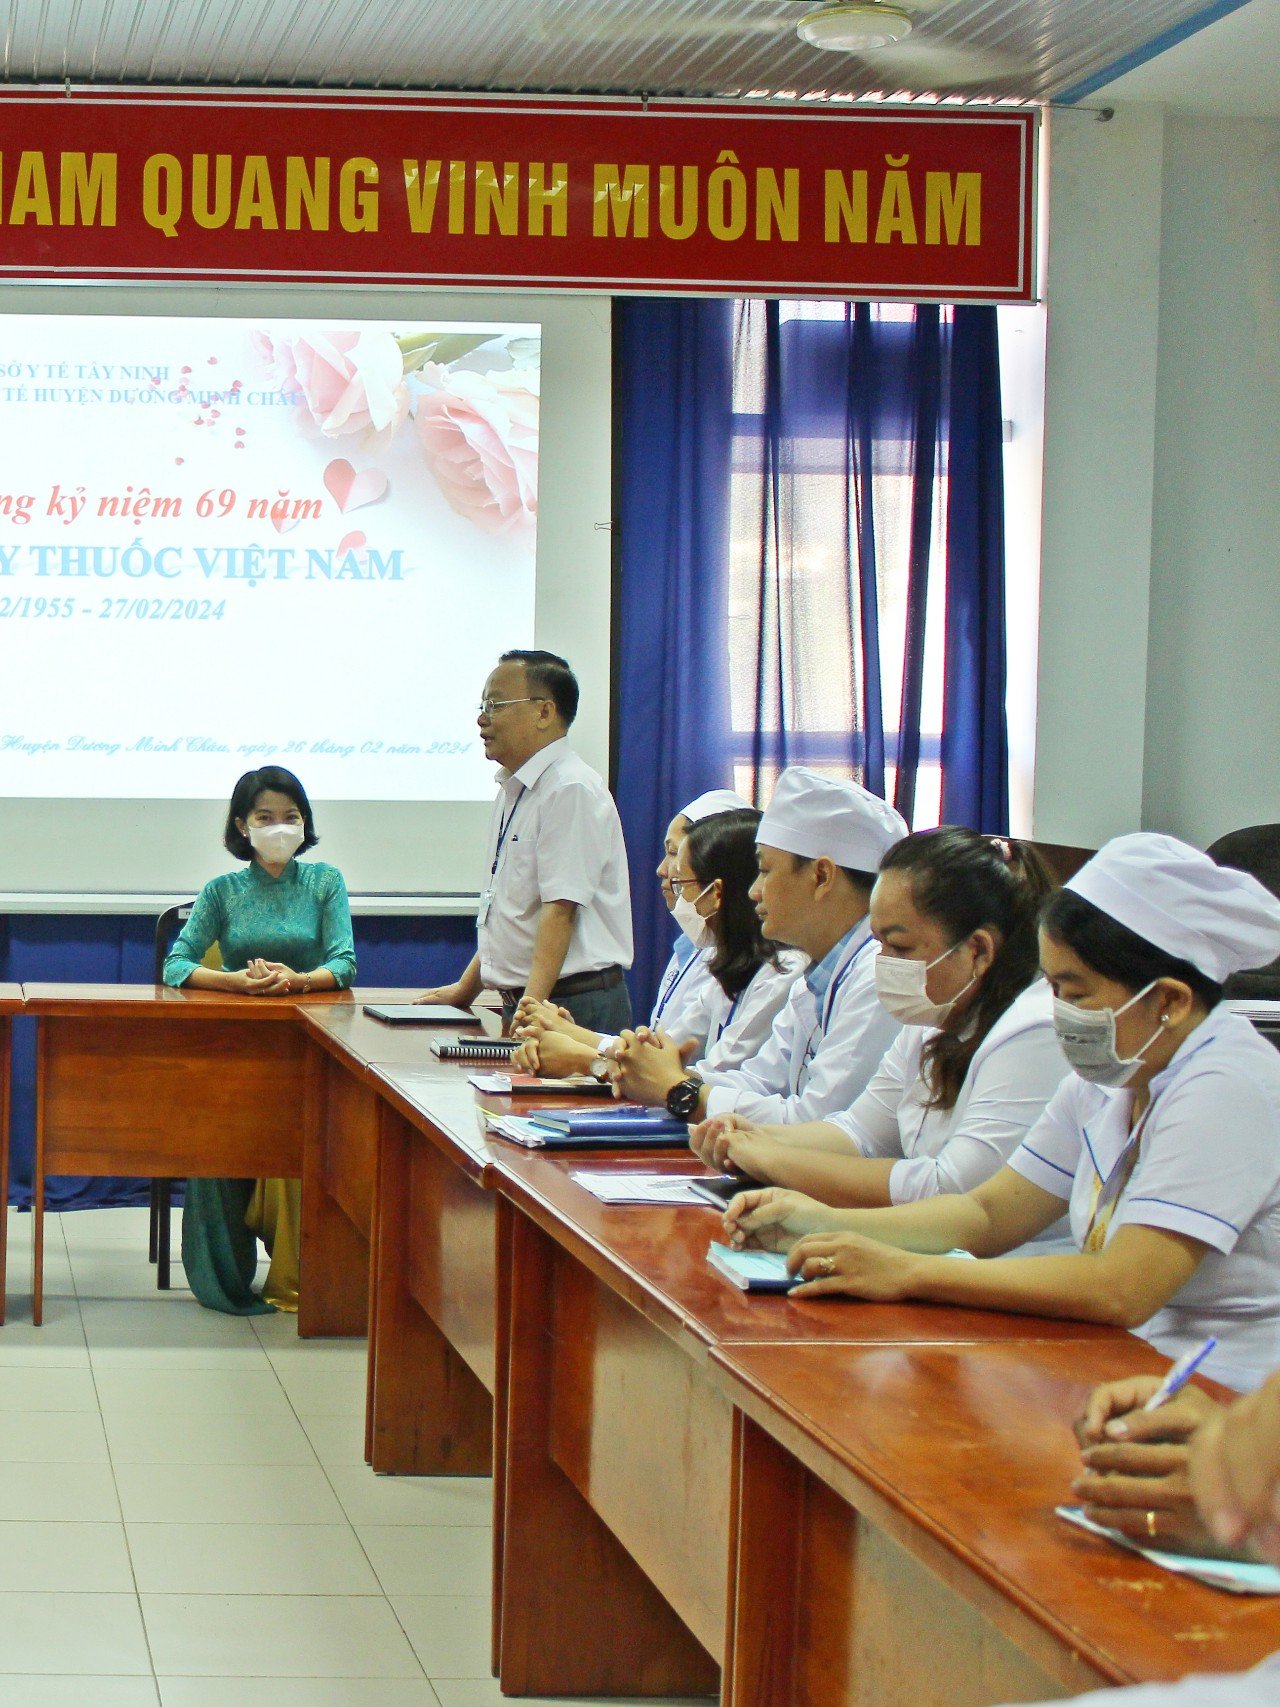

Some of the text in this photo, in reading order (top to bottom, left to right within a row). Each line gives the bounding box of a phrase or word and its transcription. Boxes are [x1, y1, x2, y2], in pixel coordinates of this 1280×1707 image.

[142, 153, 379, 238] QUANG
[403, 159, 568, 237] VINH
[592, 150, 800, 242] MUÔN
[825, 153, 982, 246] NĂM
[27, 364, 39, 378] Y
[45, 361, 69, 379] TẾ
[75, 361, 115, 380] TÂY
[120, 365, 169, 381] NINH
[3, 384, 28, 401] TẾ
[34, 386, 103, 406] HUYỆN
[109, 388, 182, 406] DƯƠNG
[188, 391, 241, 406] MINH
[247, 388, 305, 406] CHÂU
[46, 485, 87, 525] kỷ
[97, 486, 182, 526] niệm
[196, 488, 237, 518] 69
[247, 489, 323, 520] năm
[29, 537, 182, 578] THUỐC
[193, 543, 295, 588] VIỆT
[305, 548, 405, 580] NAM
[98, 598, 226, 620] 27/02/2024
[66, 735, 121, 756] Dương
[125, 736, 183, 752] Minh
[282, 740, 308, 753] 26
[309, 739, 355, 758] tháng
[359, 741, 384, 754] 02
[385, 742, 421, 754] năm
[425, 741, 473, 754] 2024
